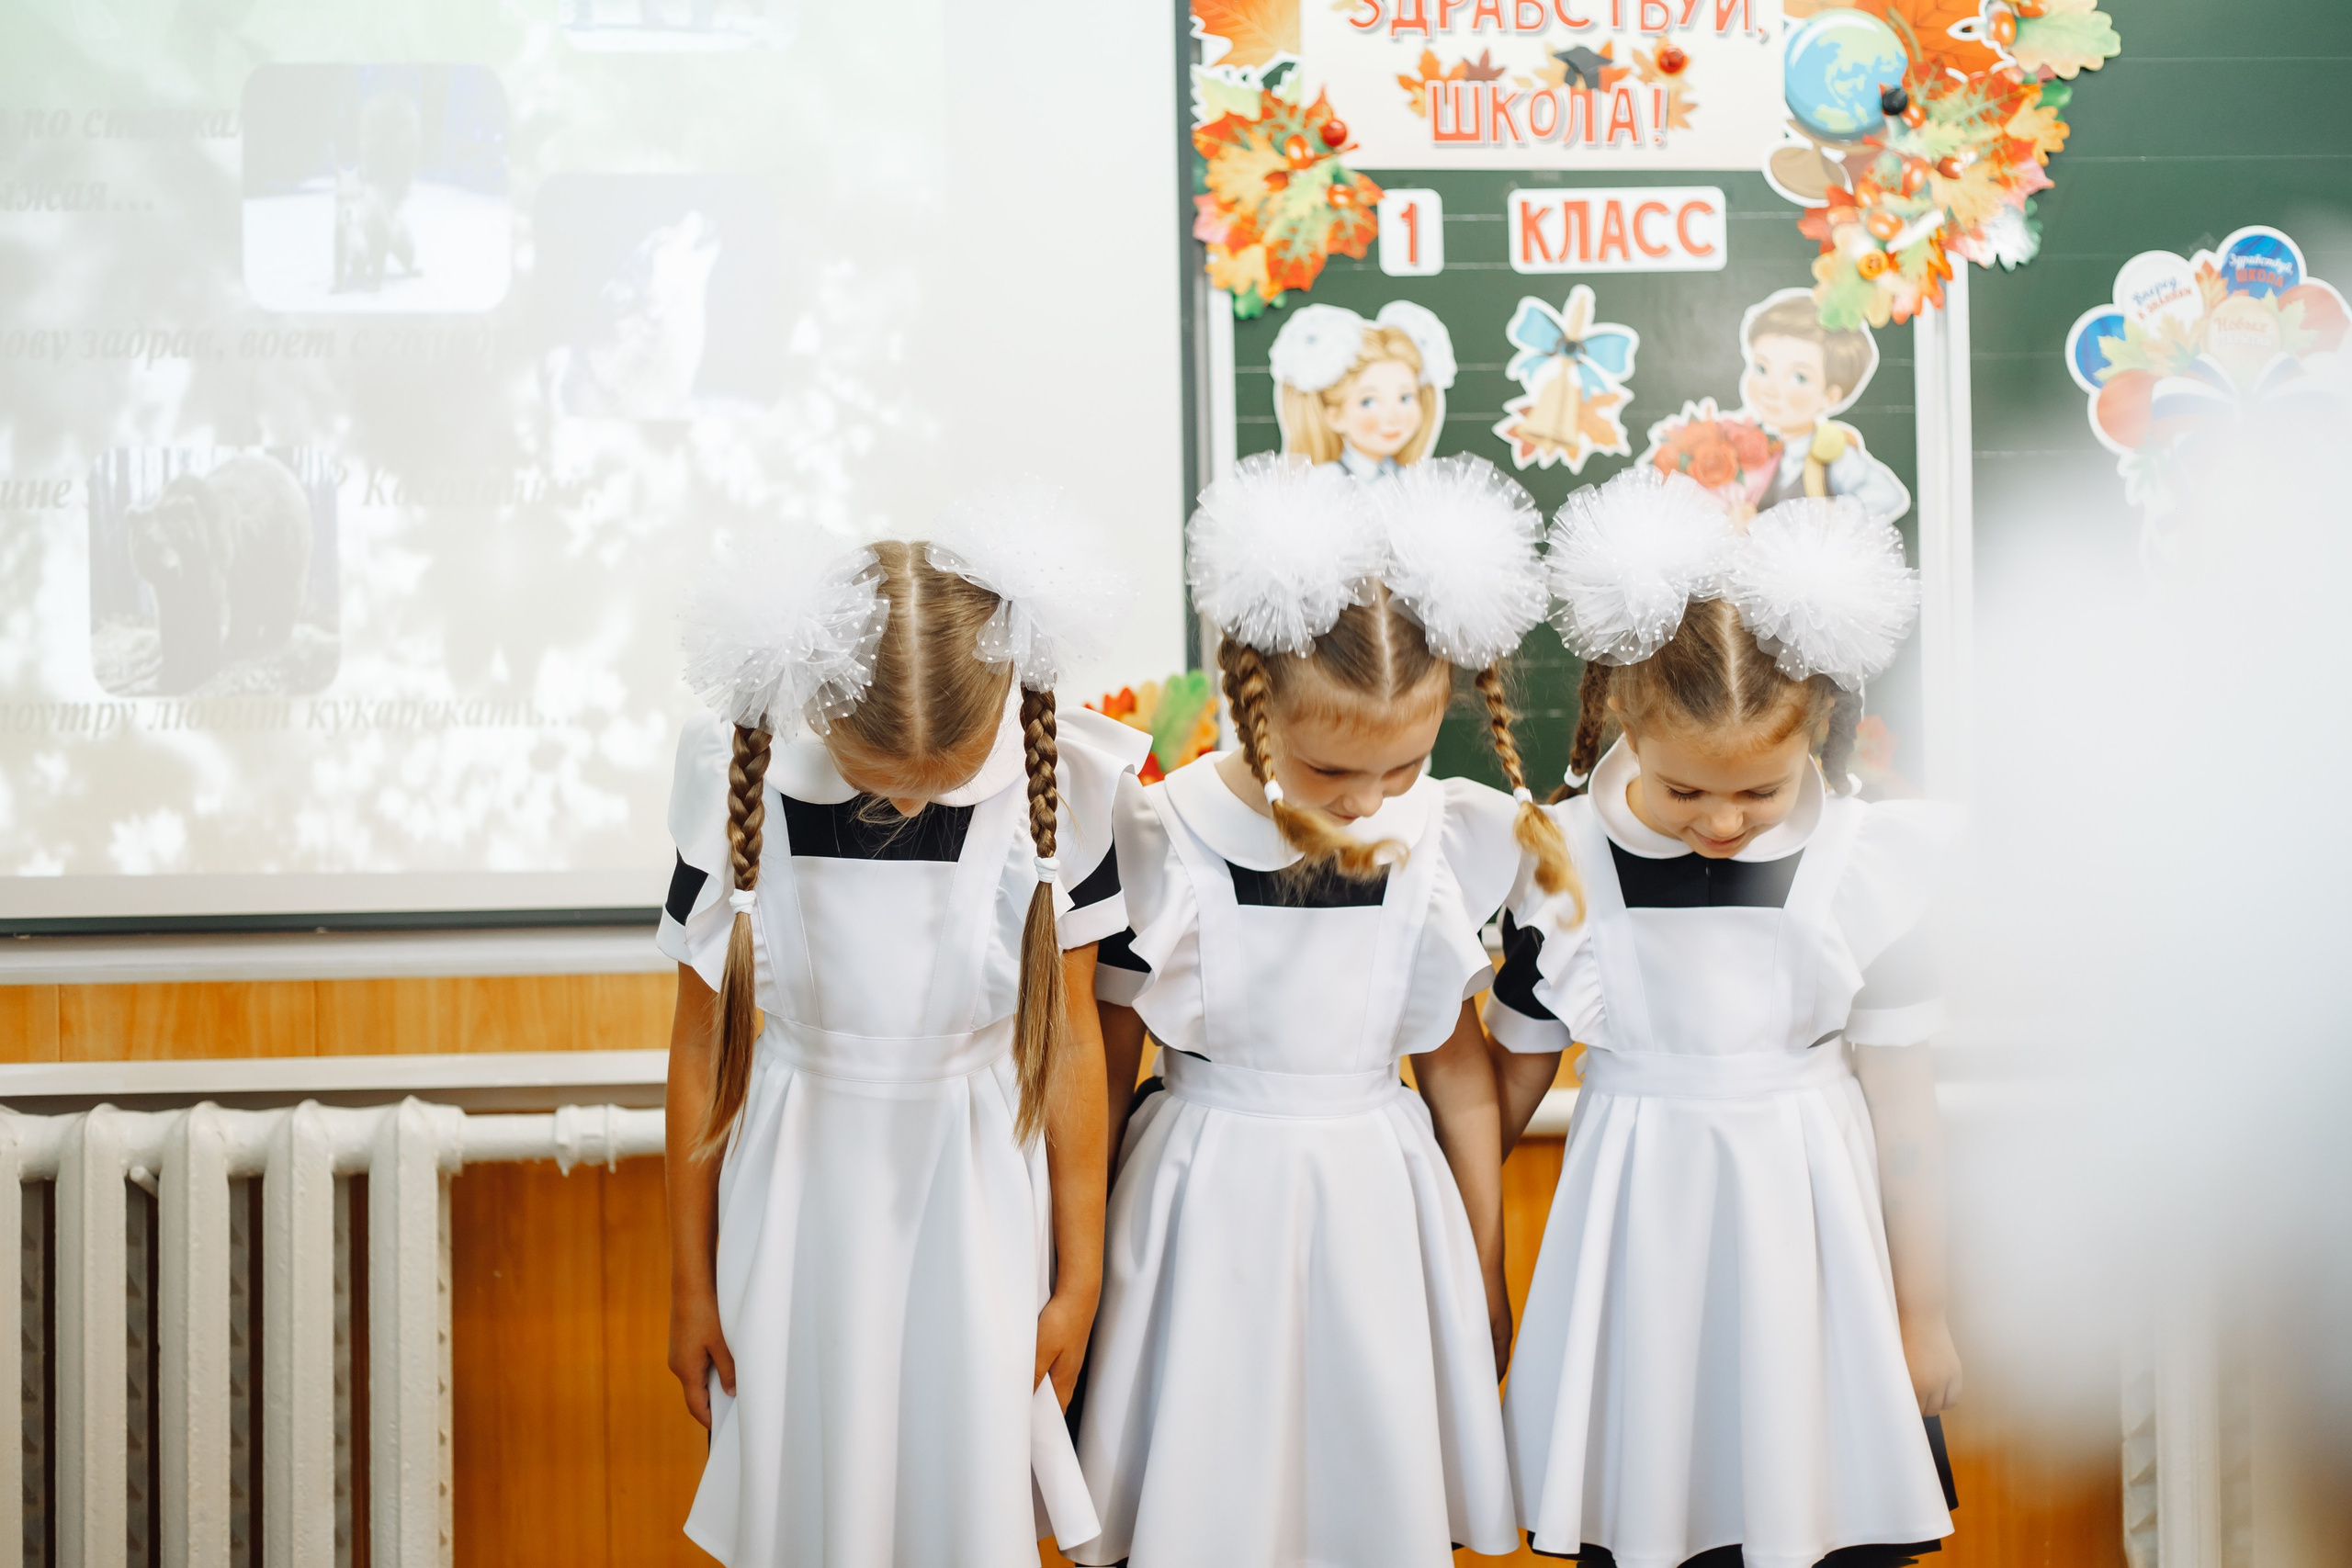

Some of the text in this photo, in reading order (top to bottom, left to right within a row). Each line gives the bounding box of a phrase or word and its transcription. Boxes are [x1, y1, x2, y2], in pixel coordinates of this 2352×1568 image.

[22, 107, 73, 139] по
[1425, 80, 1669, 148] ШКОЛА!
[1399, 199, 1717, 266] 1 КЛАСС
[0, 328, 73, 366] ову
[238, 326, 337, 359] воет
